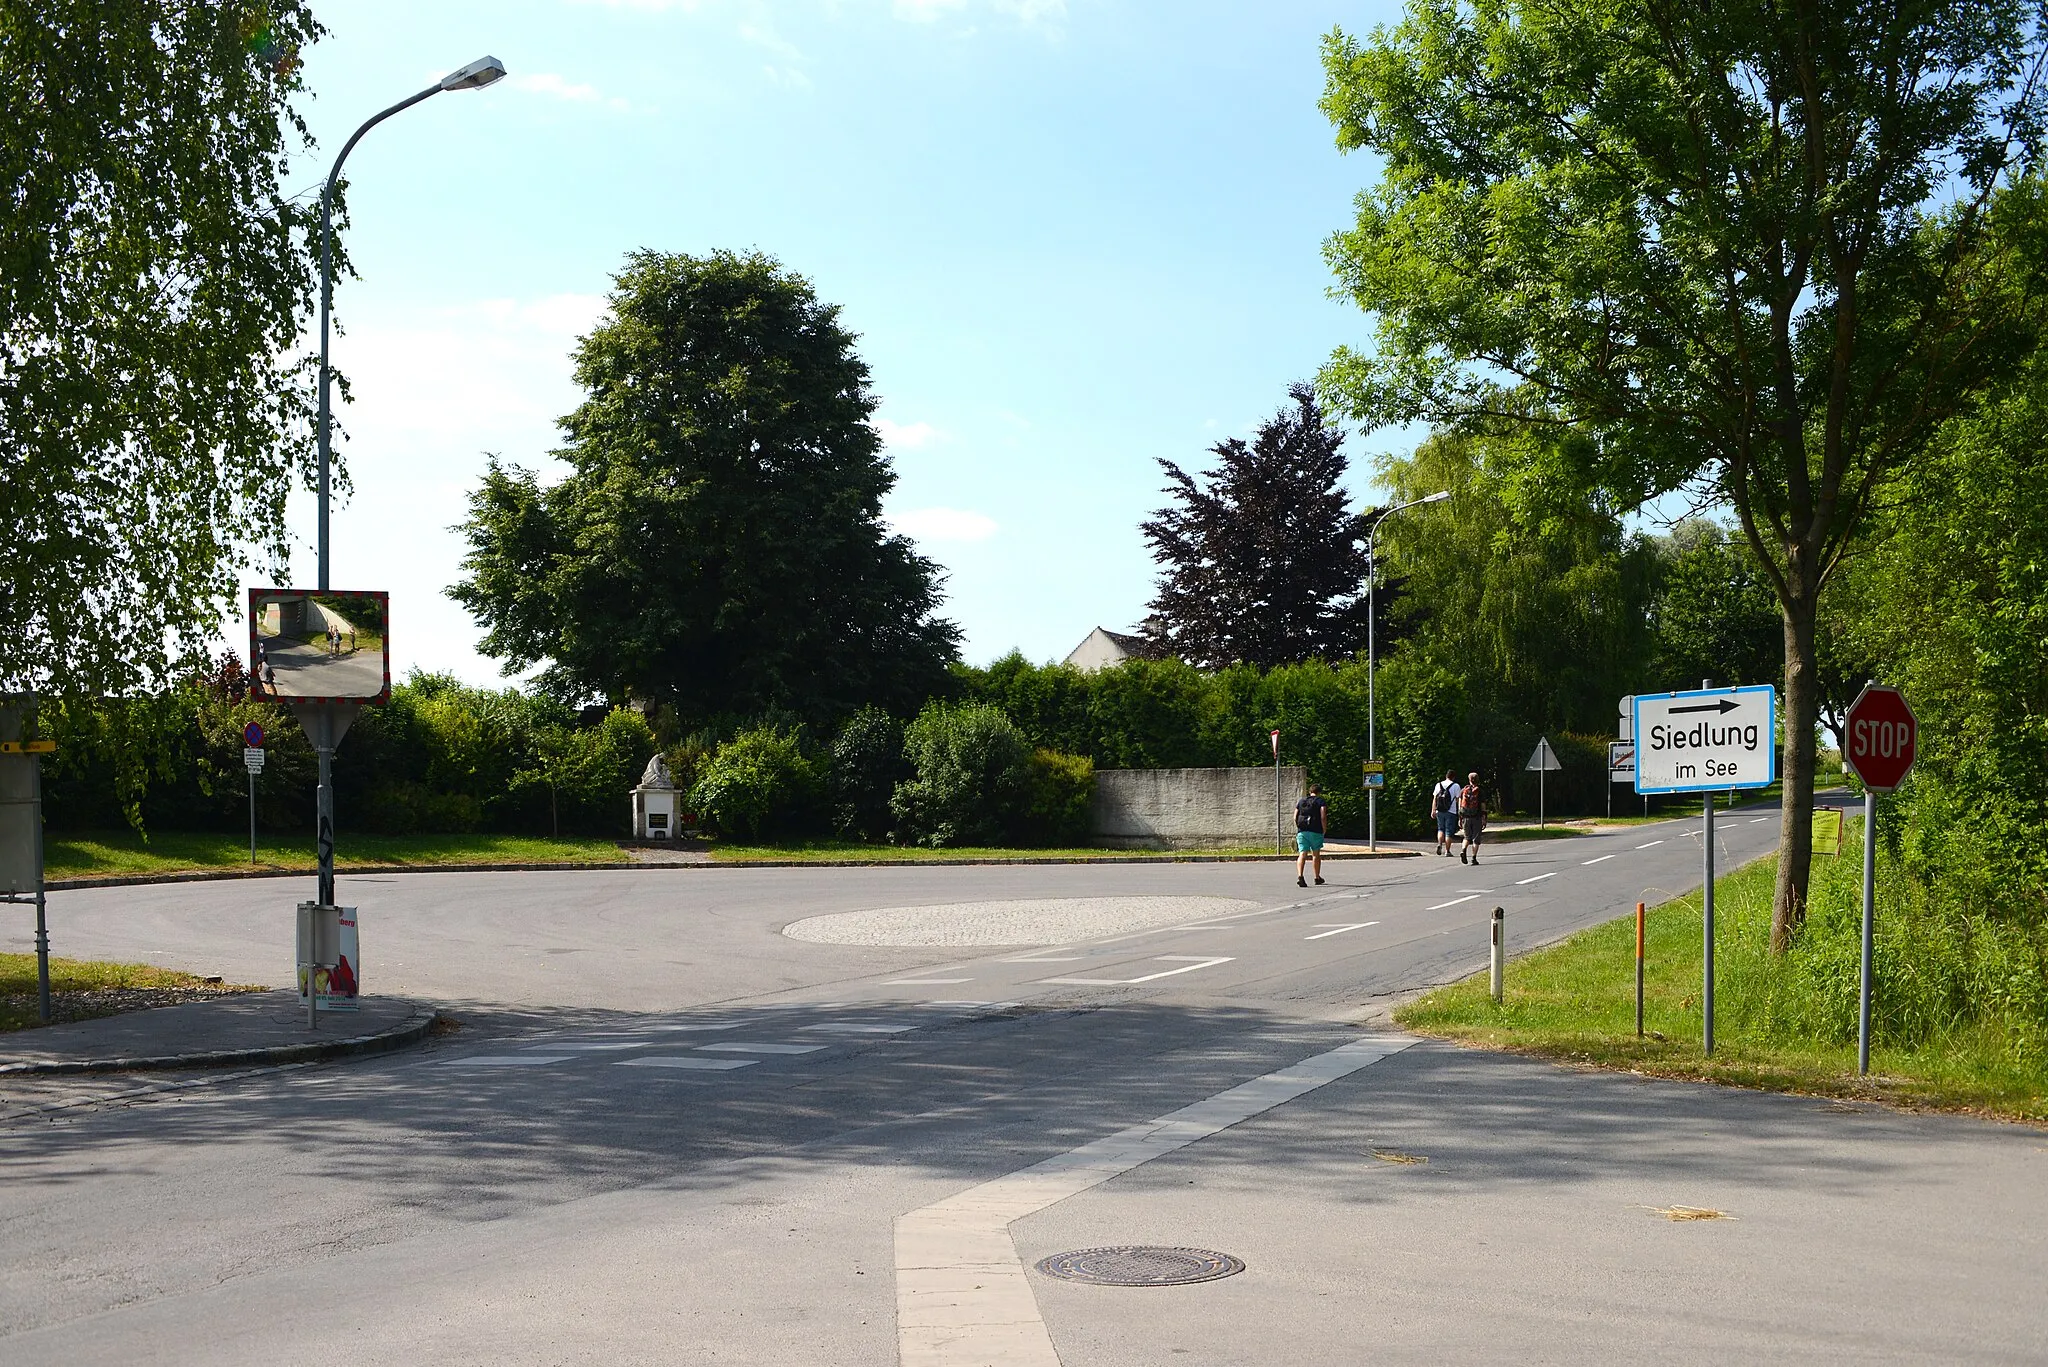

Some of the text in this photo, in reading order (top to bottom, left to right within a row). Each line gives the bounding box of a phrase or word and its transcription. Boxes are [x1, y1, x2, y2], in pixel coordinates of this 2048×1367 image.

[1651, 722, 1758, 751] Siedlung
[1855, 719, 1909, 758] STOP
[1675, 759, 1738, 779] im See
